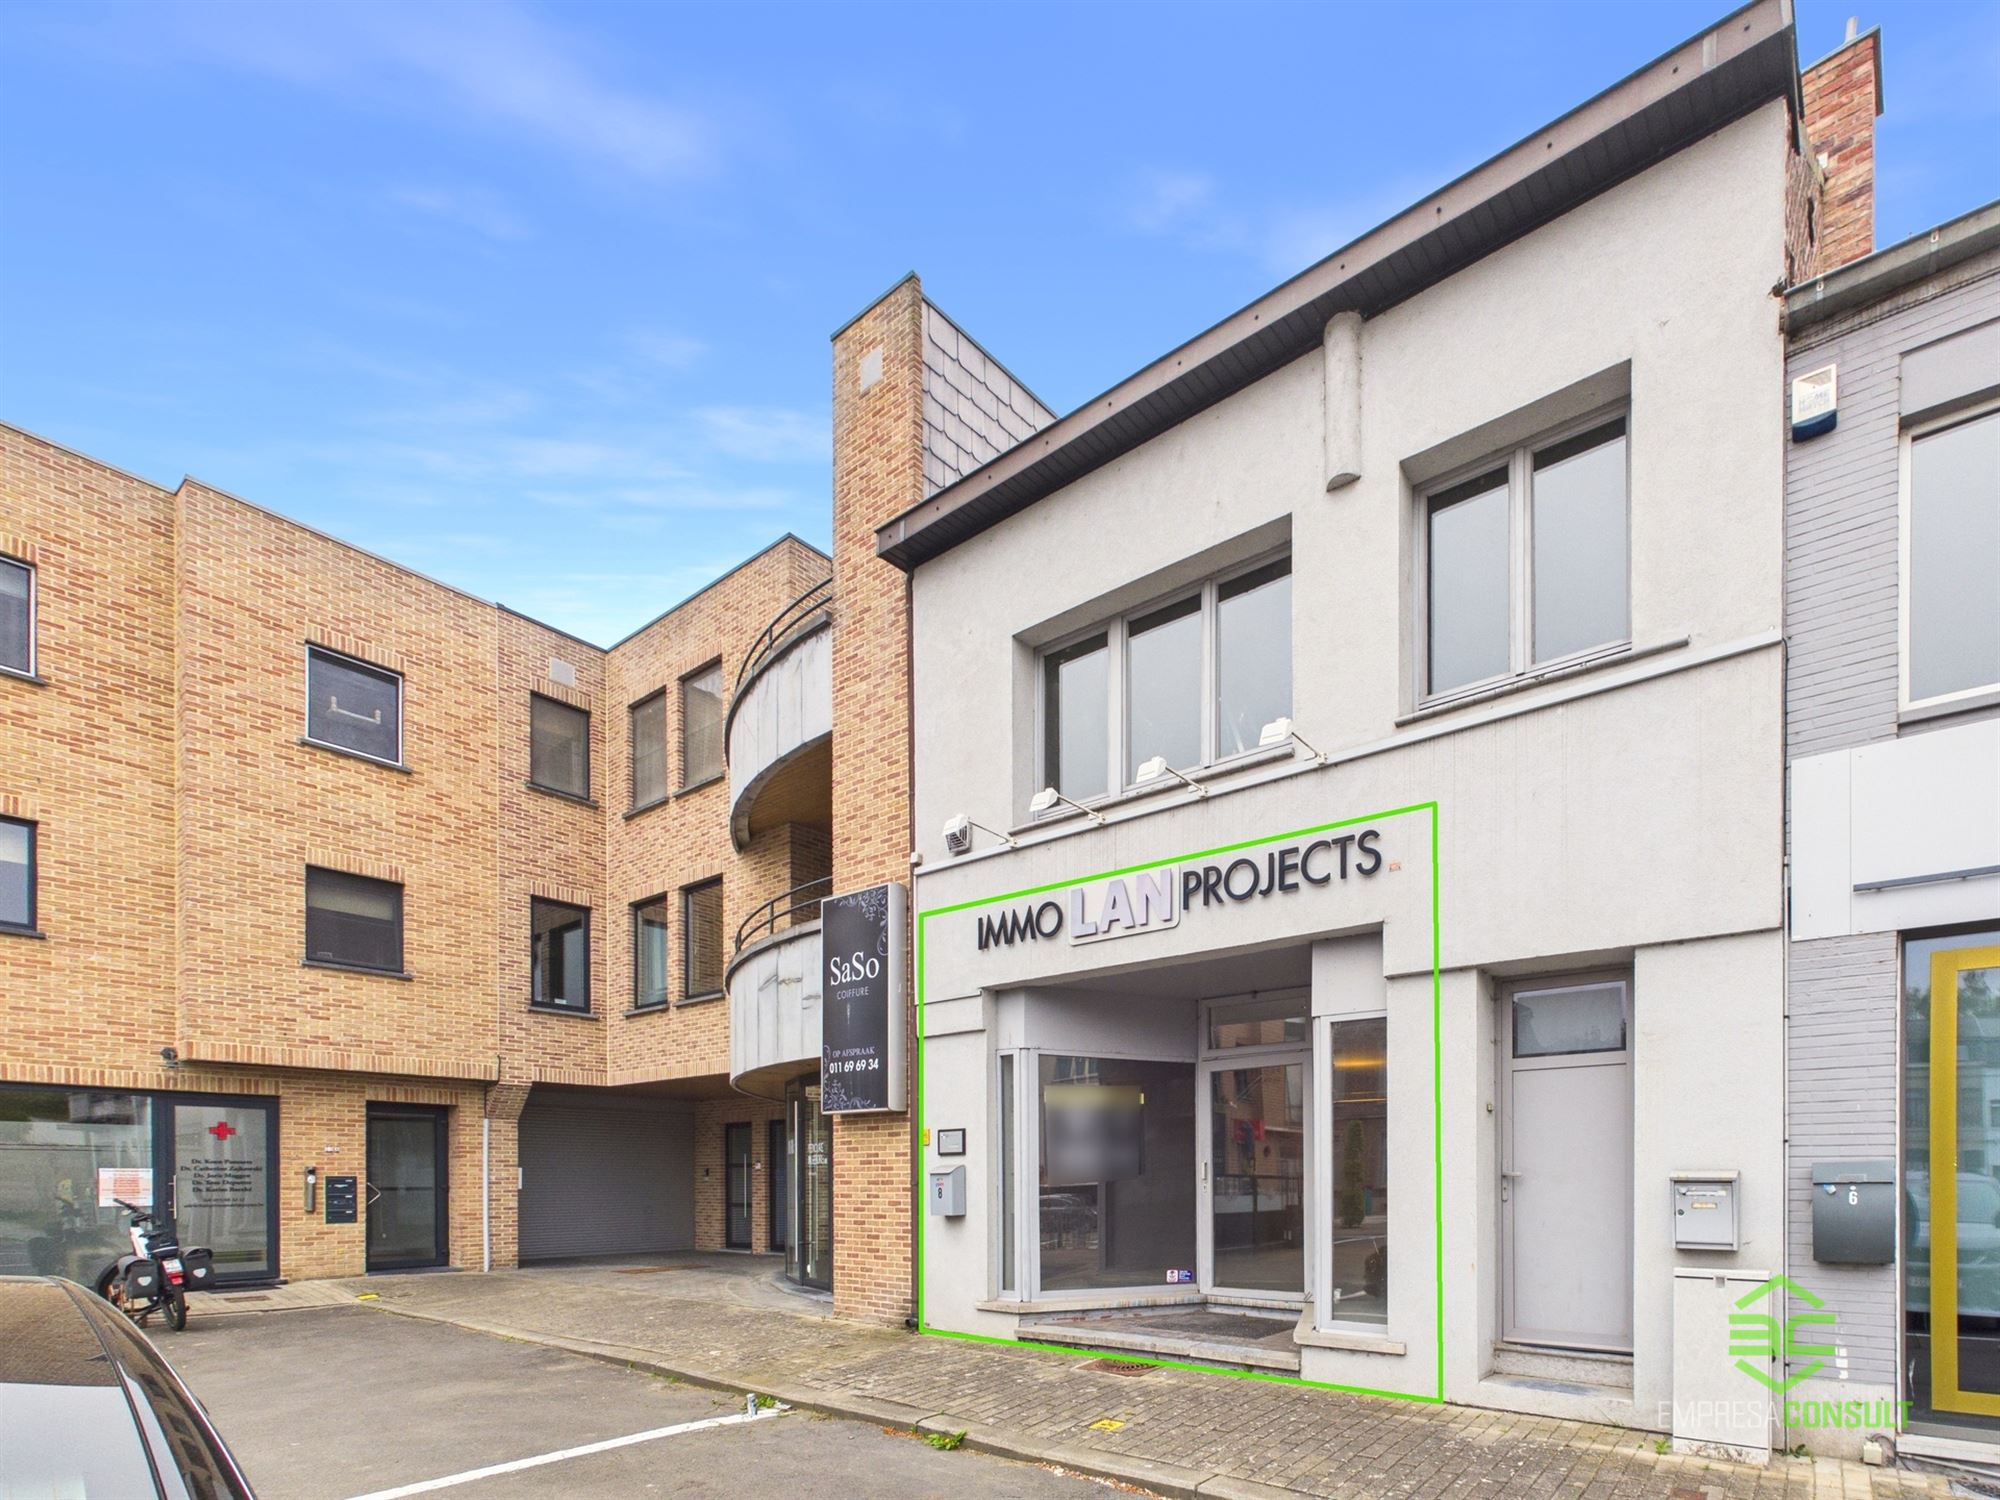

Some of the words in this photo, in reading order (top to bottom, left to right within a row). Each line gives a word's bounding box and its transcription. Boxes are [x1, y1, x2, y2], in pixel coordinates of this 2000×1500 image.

[978, 901, 1064, 950] IMMO
[1070, 867, 1173, 938] LAN
[1182, 829, 1383, 911] PROJECTS
[830, 951, 880, 986] SaSo
[836, 986, 870, 1000] COIFFURE
[832, 1050, 841, 1058] OP
[841, 1046, 876, 1057] AFSPRAAK
[829, 1061, 842, 1074] 011
[844, 1060, 854, 1073] 69
[855, 1059, 867, 1072] 69
[868, 1058, 879, 1071] 34
[937, 1187, 943, 1199] 8
[1849, 1191, 1858, 1205] 6
